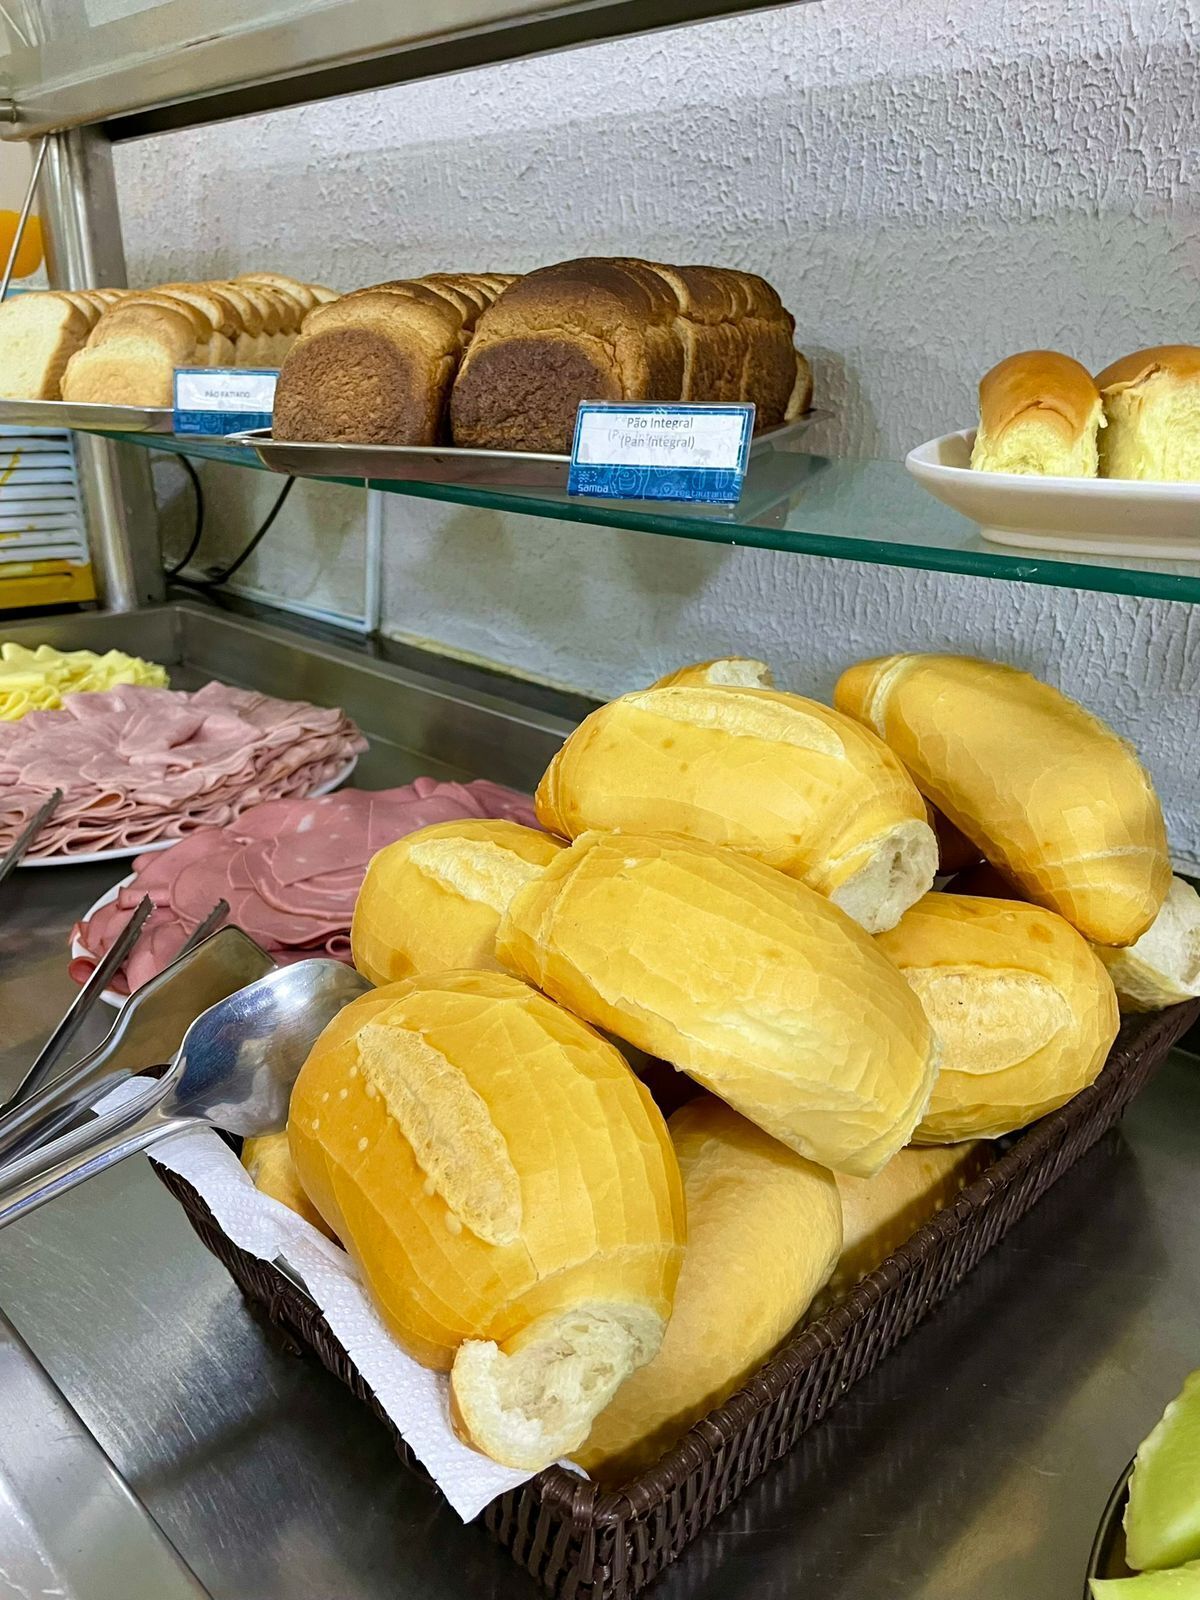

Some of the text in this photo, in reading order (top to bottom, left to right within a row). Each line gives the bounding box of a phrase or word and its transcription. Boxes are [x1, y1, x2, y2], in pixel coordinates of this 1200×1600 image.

[627, 417, 647, 429] Pão
[650, 417, 694, 431] Integral
[648, 436, 695, 449] Integral)
